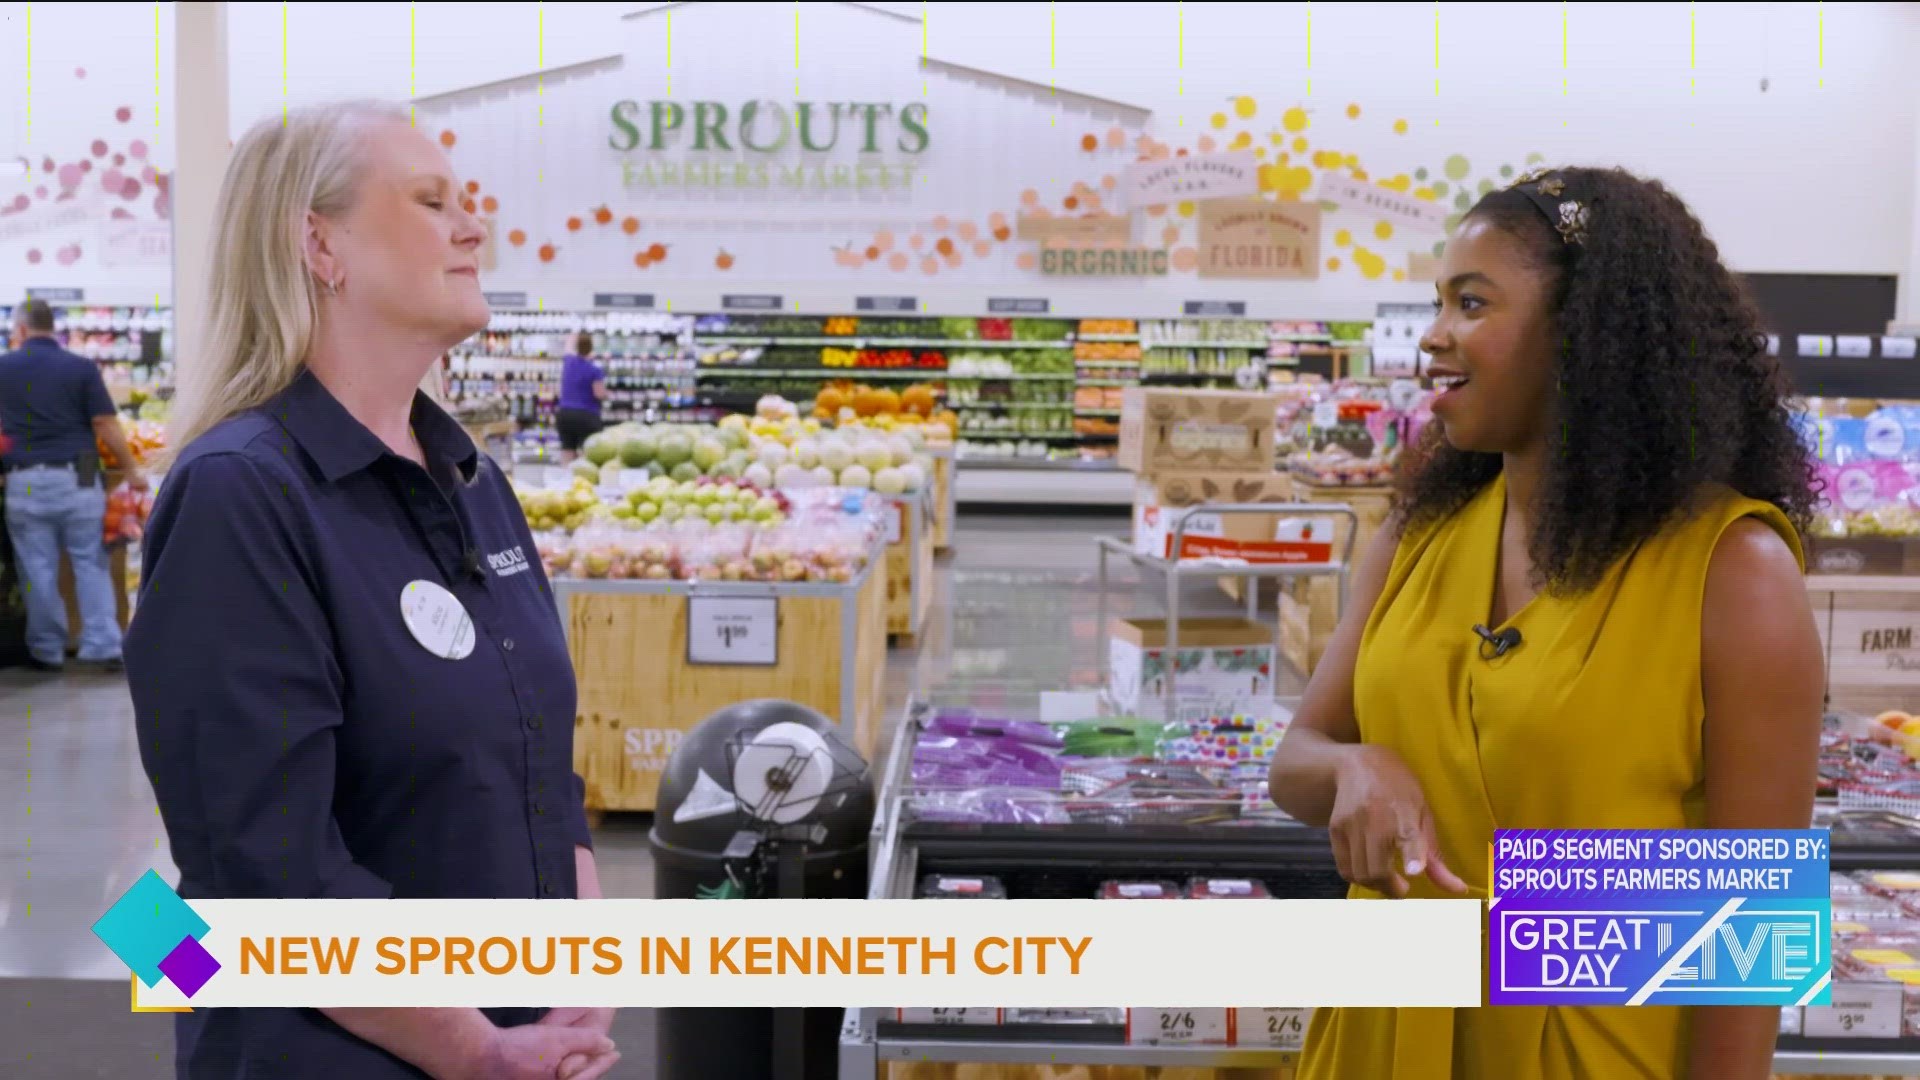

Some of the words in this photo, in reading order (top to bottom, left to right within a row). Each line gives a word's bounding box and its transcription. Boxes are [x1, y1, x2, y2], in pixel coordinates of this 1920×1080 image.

[608, 98, 931, 154] SPROUTS
[621, 160, 770, 189] FARMERS
[778, 160, 917, 189] MARKET
[1040, 249, 1169, 276] ORGANIC
[1209, 245, 1303, 269] FLORIDA
[1860, 627, 1912, 653] FARM
[1160, 1012, 1195, 1031] 2/6
[1267, 1015, 1303, 1034] 2/6
